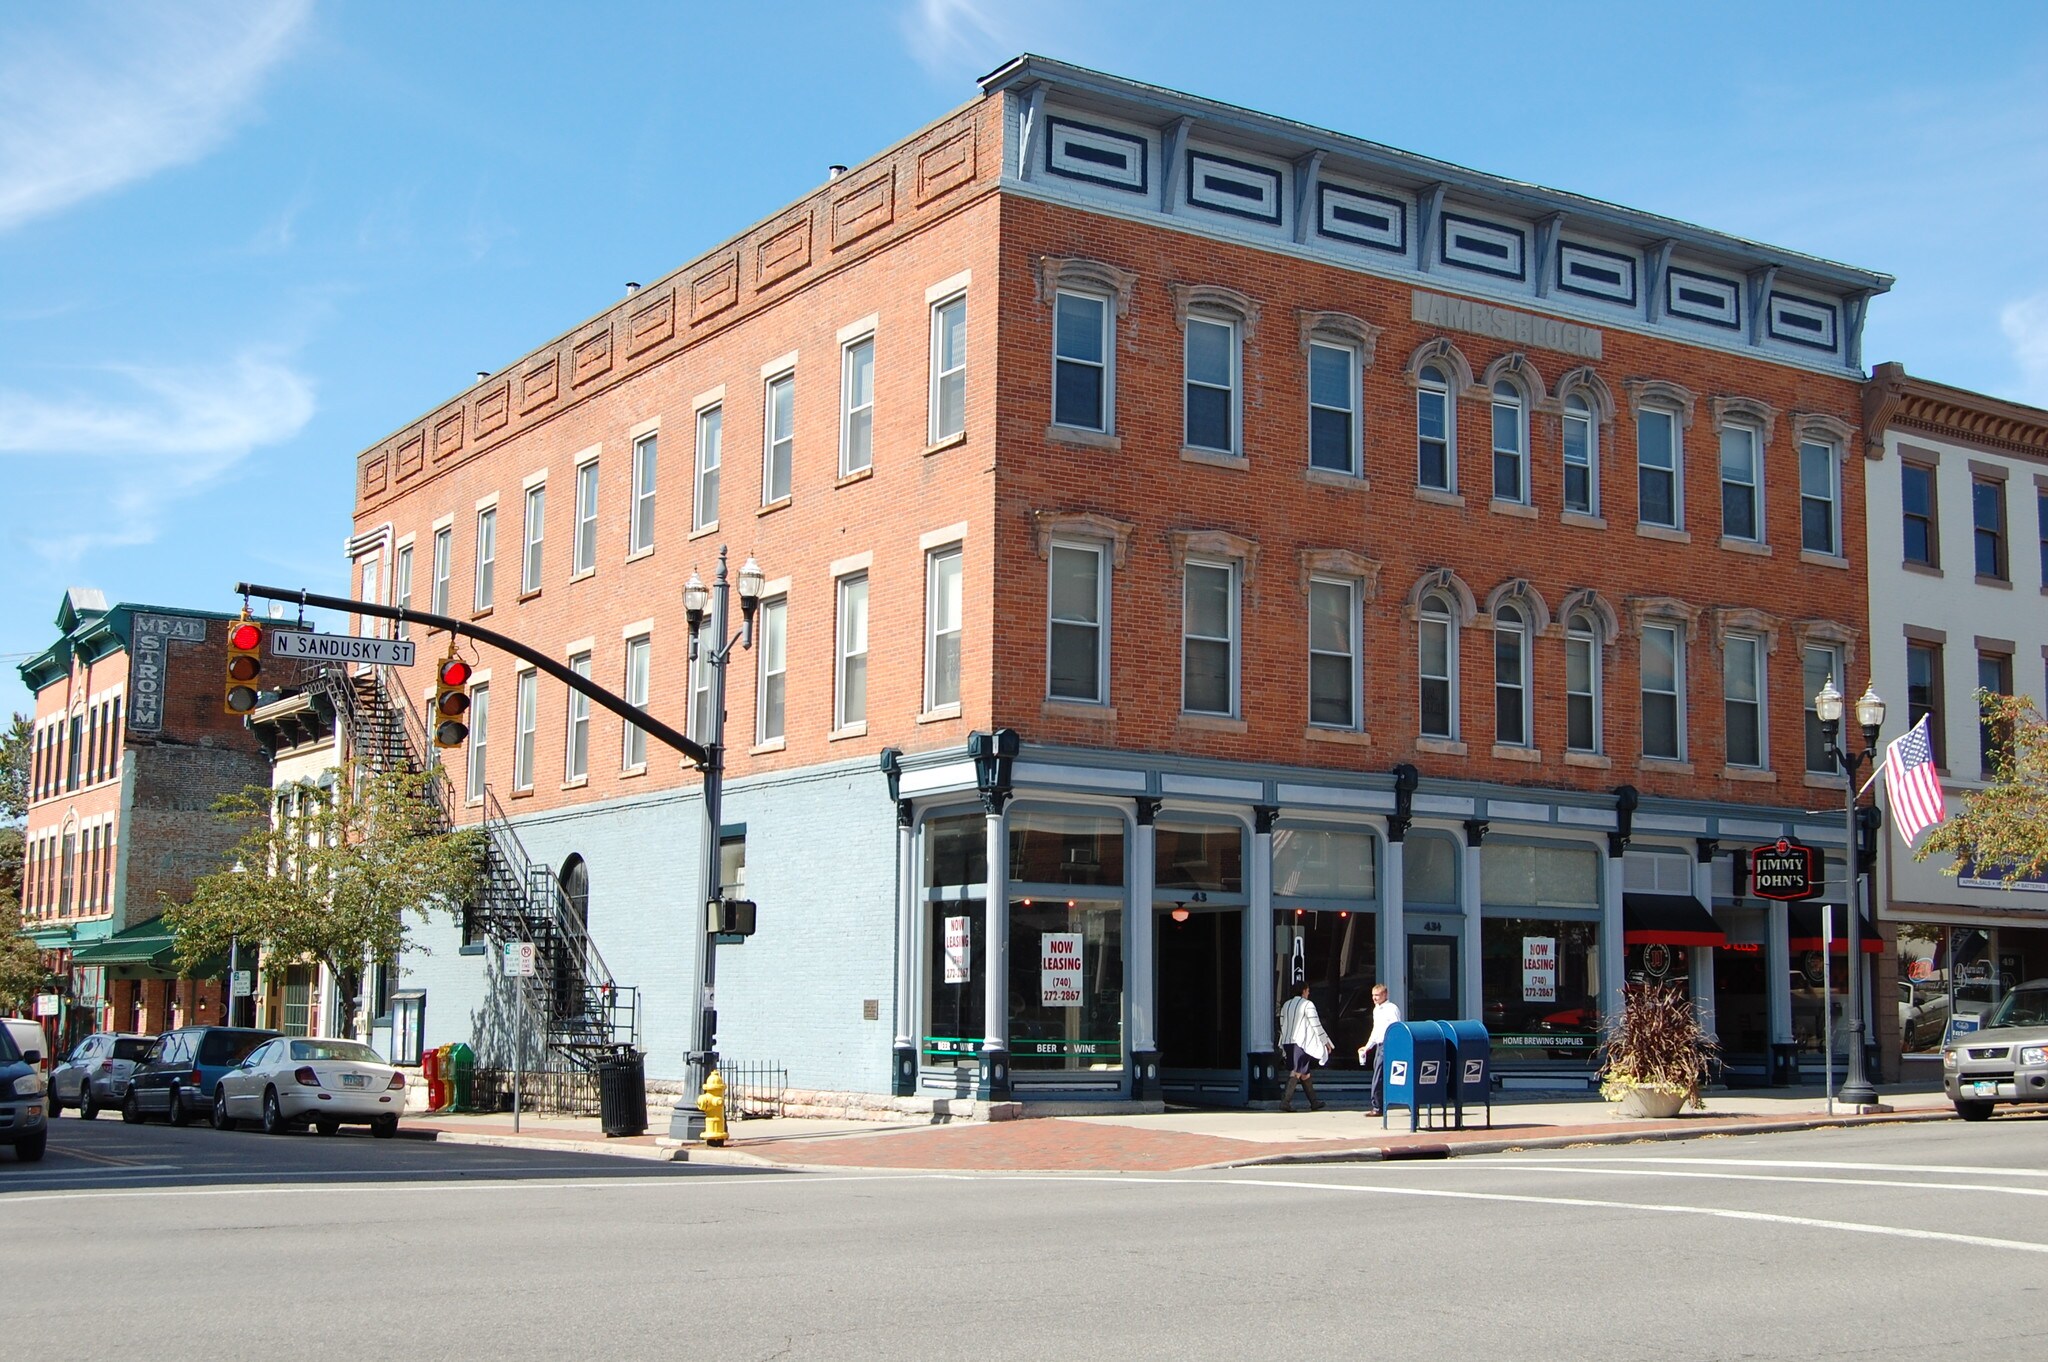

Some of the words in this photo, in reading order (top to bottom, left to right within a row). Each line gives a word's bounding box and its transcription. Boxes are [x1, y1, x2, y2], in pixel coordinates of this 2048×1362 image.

[136, 618, 199, 637] MEAT
[278, 636, 288, 651] N
[298, 637, 381, 659] SANDUSKY
[392, 644, 410, 662] ST
[135, 635, 160, 724] STROHM
[1756, 859, 1804, 874] JIMMY
[1756, 875, 1804, 890] JOHN'S
[1191, 891, 1207, 902] 43
[951, 919, 964, 931] NOW
[946, 935, 968, 948] LEASING
[1050, 941, 1073, 953] NOW
[1530, 944, 1548, 956] NOW
[1043, 957, 1081, 970] LEASING
[1524, 959, 1554, 971] LEASING
[1052, 977, 1071, 988] (740)
[1532, 976, 1547, 986] (740)
[1043, 990, 1080, 1001] 272-2867
[1525, 987, 1554, 997] 272-2867
[938, 1041, 950, 1050] BEER
[960, 1042, 974, 1052] WINE
[1502, 1037, 1523, 1045] HOME
[1524, 1037, 1554, 1045] BREWING
[1555, 1038, 1584, 1046] SUPPLIES
[1037, 1044, 1057, 1053] BEER
[1074, 1044, 1096, 1053] WINE
